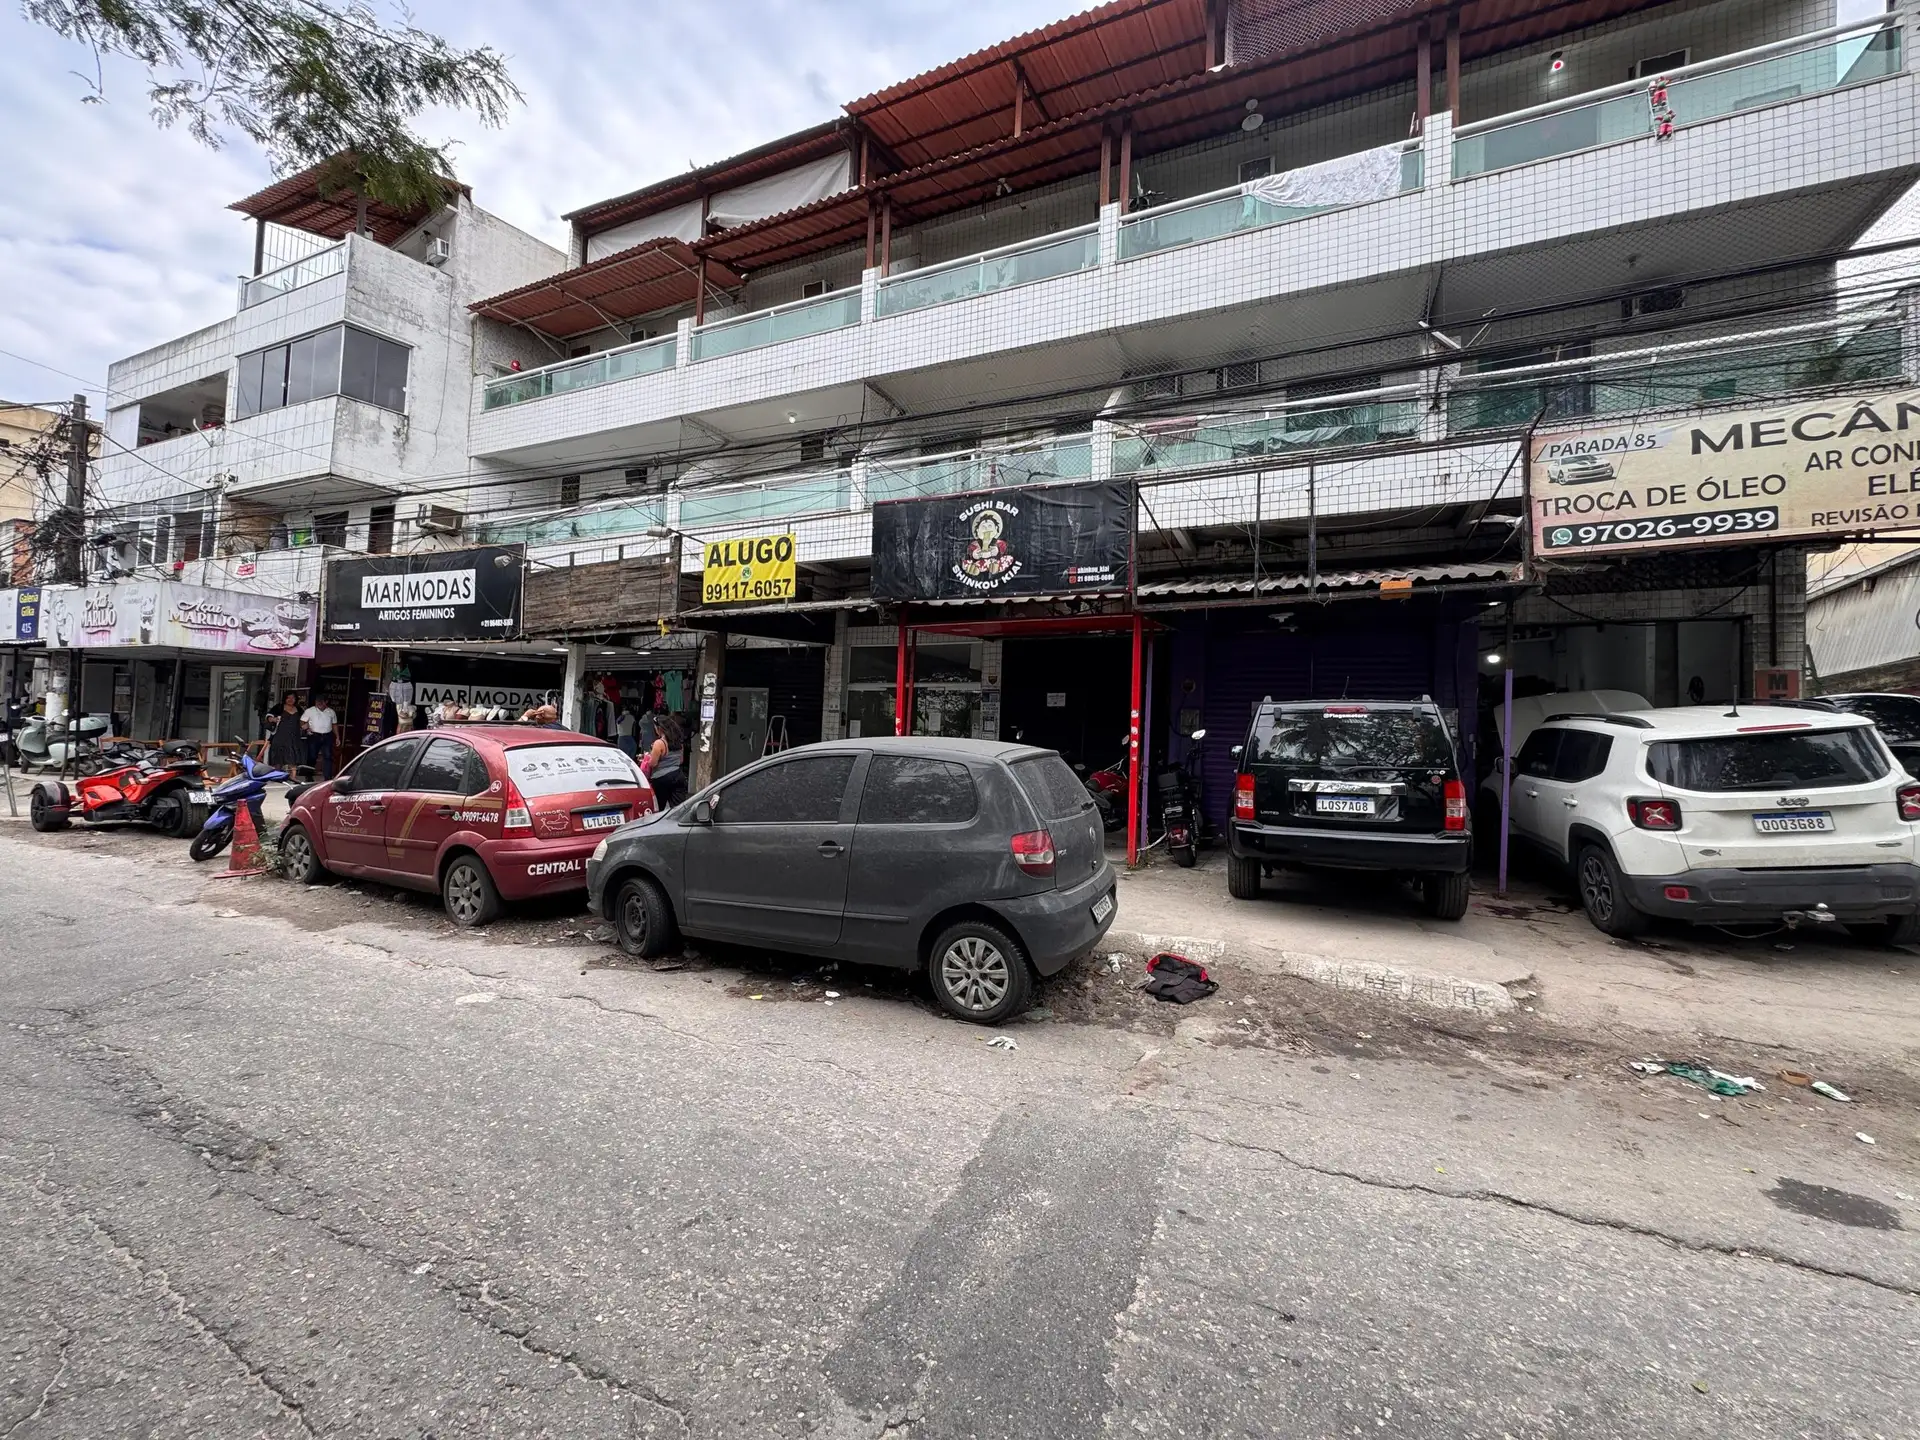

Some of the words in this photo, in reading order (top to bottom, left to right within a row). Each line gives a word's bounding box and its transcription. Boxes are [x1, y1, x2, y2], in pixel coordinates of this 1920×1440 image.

[1549, 436, 1628, 458] PARADA
[1635, 433, 1656, 448] 85
[1804, 450, 1843, 473] AR
[1851, 441, 1920, 467] CON
[1537, 490, 1637, 517] TROCA
[1646, 484, 1687, 507] DE
[1697, 474, 1787, 502] ÓLEO
[959, 500, 993, 522] SUSHI
[995, 501, 1020, 517] BAR
[1811, 503, 1909, 527] REVISÃO
[1578, 509, 1776, 544] 97026-9939
[707, 536, 793, 568] ALUGO
[952, 564, 999, 590] SHINKOU
[1001, 561, 1023, 583] KIAI
[365, 582, 402, 603] MAR
[406, 576, 472, 602] MODAS
[706, 578, 791, 601] 99117-6057
[167, 608, 240, 629] MARUJO
[378, 609, 410, 620] ARTIGOS
[412, 607, 455, 620] FEMININOS
[21, 622, 32, 633] 415
[420, 687, 467, 704] MAR
[474, 690, 546, 706] MODAS
[1776, 797, 1810, 806] Jeep
[527, 860, 581, 876] CENTRAL
